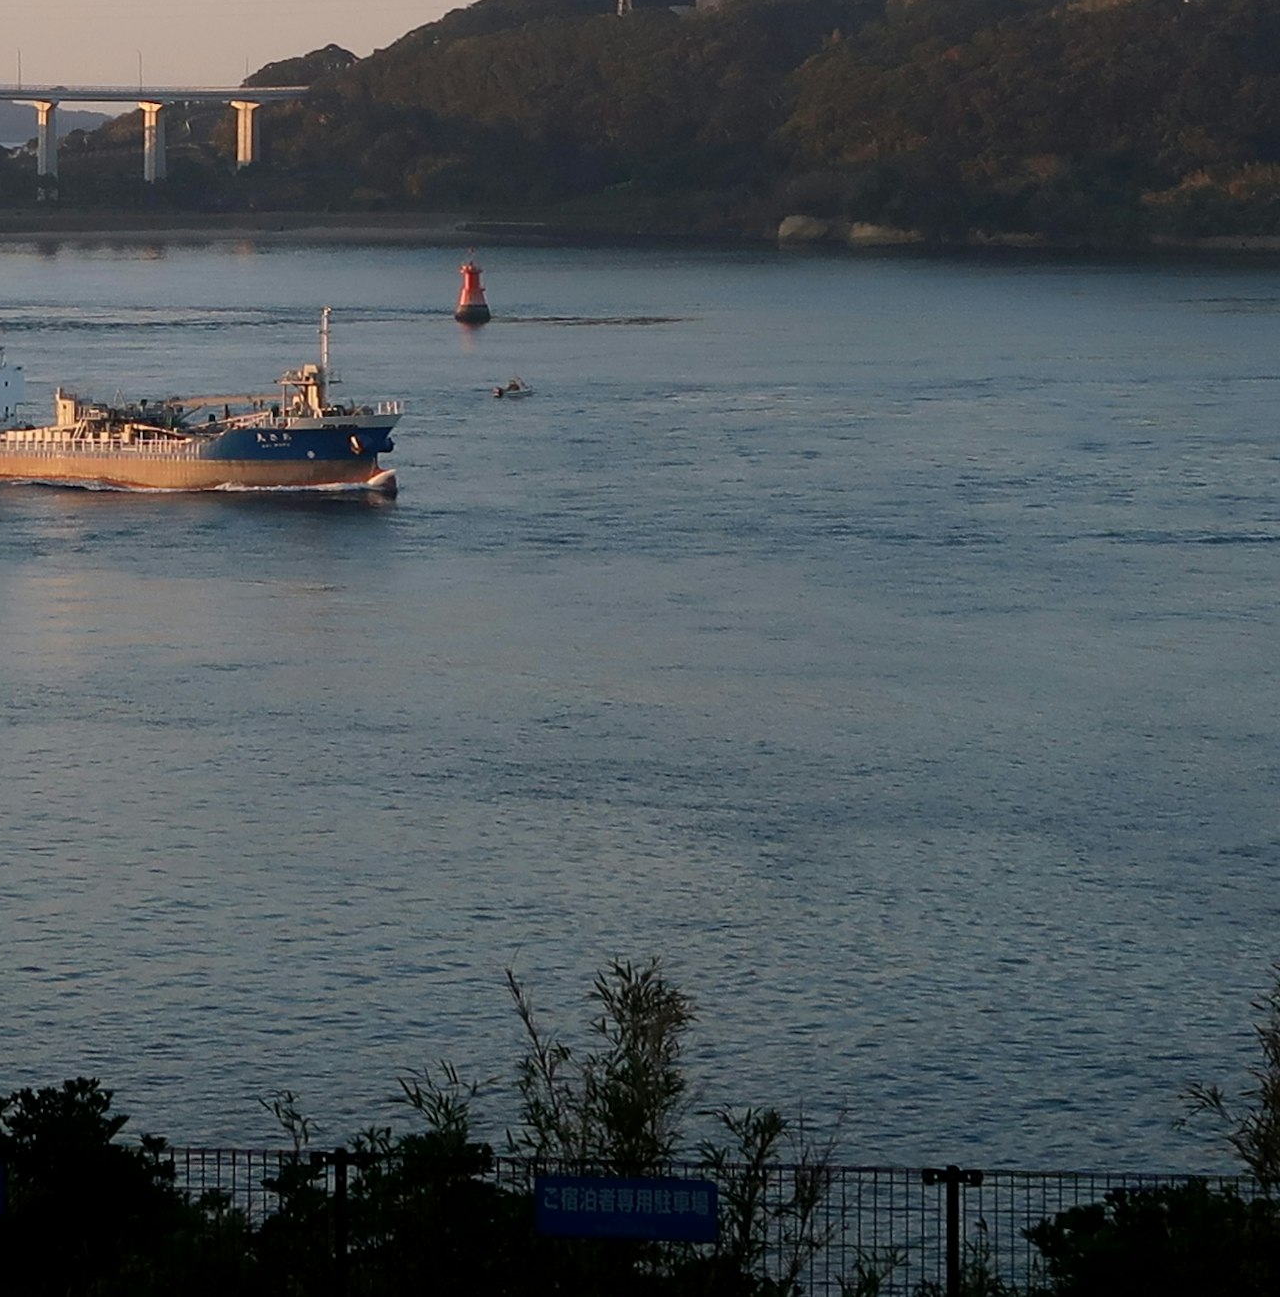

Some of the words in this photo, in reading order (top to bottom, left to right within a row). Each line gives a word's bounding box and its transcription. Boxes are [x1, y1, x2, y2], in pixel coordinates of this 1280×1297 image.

[543, 1185, 709, 1216] ご宿泊者専用駐車場
